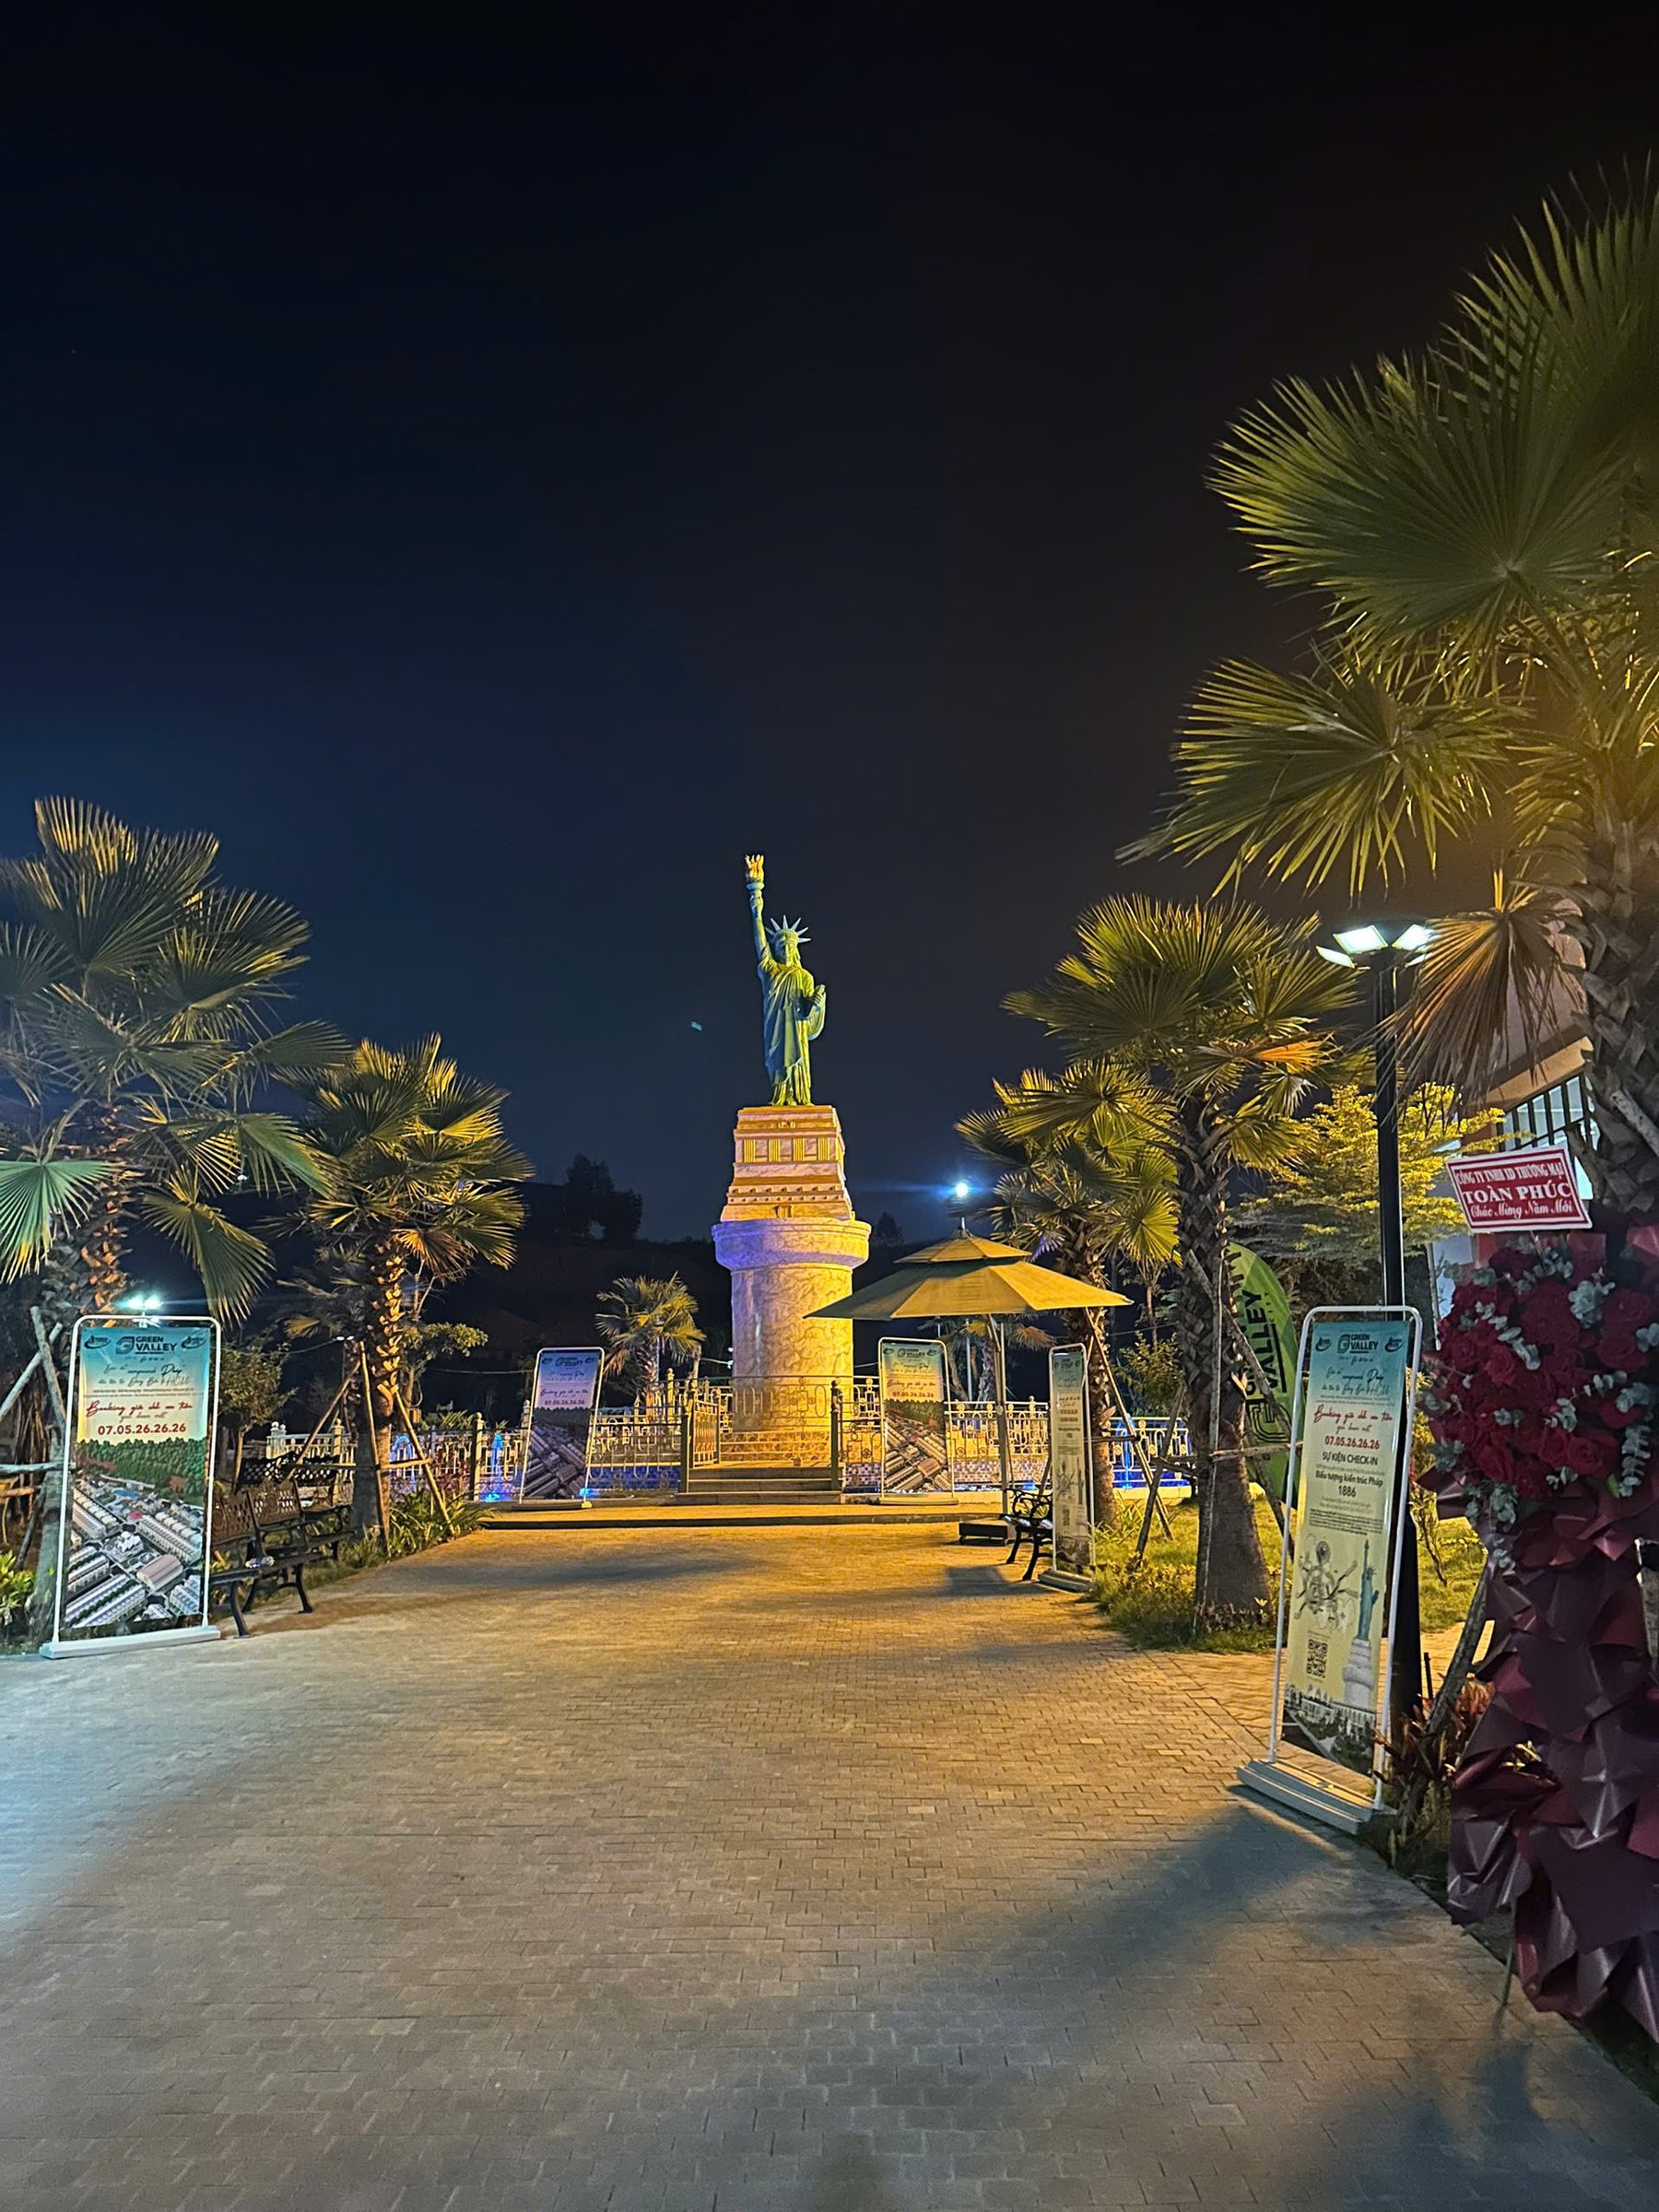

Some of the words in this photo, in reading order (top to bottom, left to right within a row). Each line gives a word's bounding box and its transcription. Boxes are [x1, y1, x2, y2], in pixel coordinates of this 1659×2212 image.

[1474, 1171, 1485, 1183] TY
[1462, 1184, 1513, 1205] TOÀN
[1516, 1180, 1572, 1200] PHÚC
[1470, 1205, 1493, 1218] Chúc
[1494, 1201, 1523, 1220] Mừng
[1524, 1200, 1548, 1215] Năm
[1550, 1198, 1573, 1214] Mới
[1241, 1289, 1277, 1389] VALLEY
[1350, 1341, 1379, 1350] VALLEY
[135, 1343, 178, 1351] VALLEY
[86, 1400, 126, 1418] Booking
[98, 1422, 187, 1436] 07.05.26.26.26
[1324, 1435, 1381, 1450] 07.05.26.26.26
[1322, 1451, 1332, 1463] SỰ
[1332, 1451, 1346, 1464] KIỆN
[1347, 1453, 1379, 1465] CHECK-IN
[1369, 1476, 1383, 1488] Pháp
[1338, 1485, 1356, 1498] 1886
